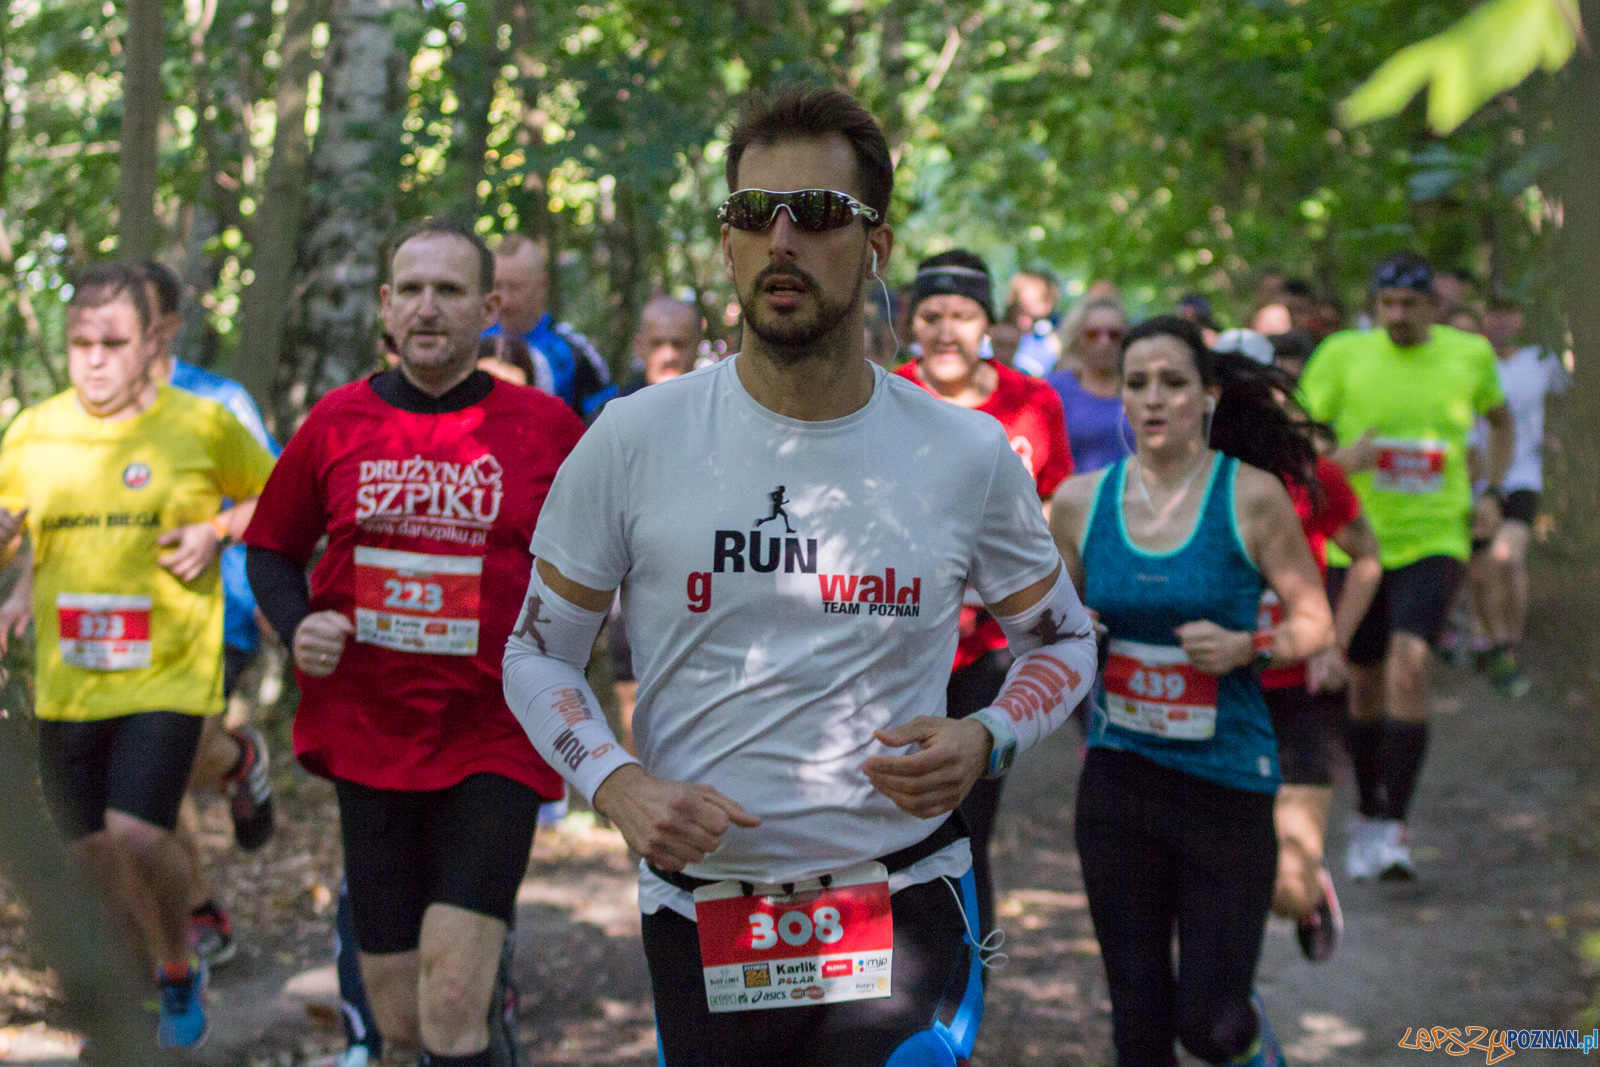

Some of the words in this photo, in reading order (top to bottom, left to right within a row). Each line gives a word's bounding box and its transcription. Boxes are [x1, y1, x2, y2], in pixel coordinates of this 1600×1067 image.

[359, 454, 478, 487] DRUŻYNA
[356, 482, 503, 523] SZPIKU
[713, 530, 817, 573] RUN
[384, 579, 443, 611] 223
[823, 601, 860, 615] TEAM
[1128, 669, 1186, 700] 439
[749, 906, 844, 950] 308
[776, 961, 818, 975] Karlik
[867, 957, 888, 968] mjp
[856, 982, 876, 991] Rotary
